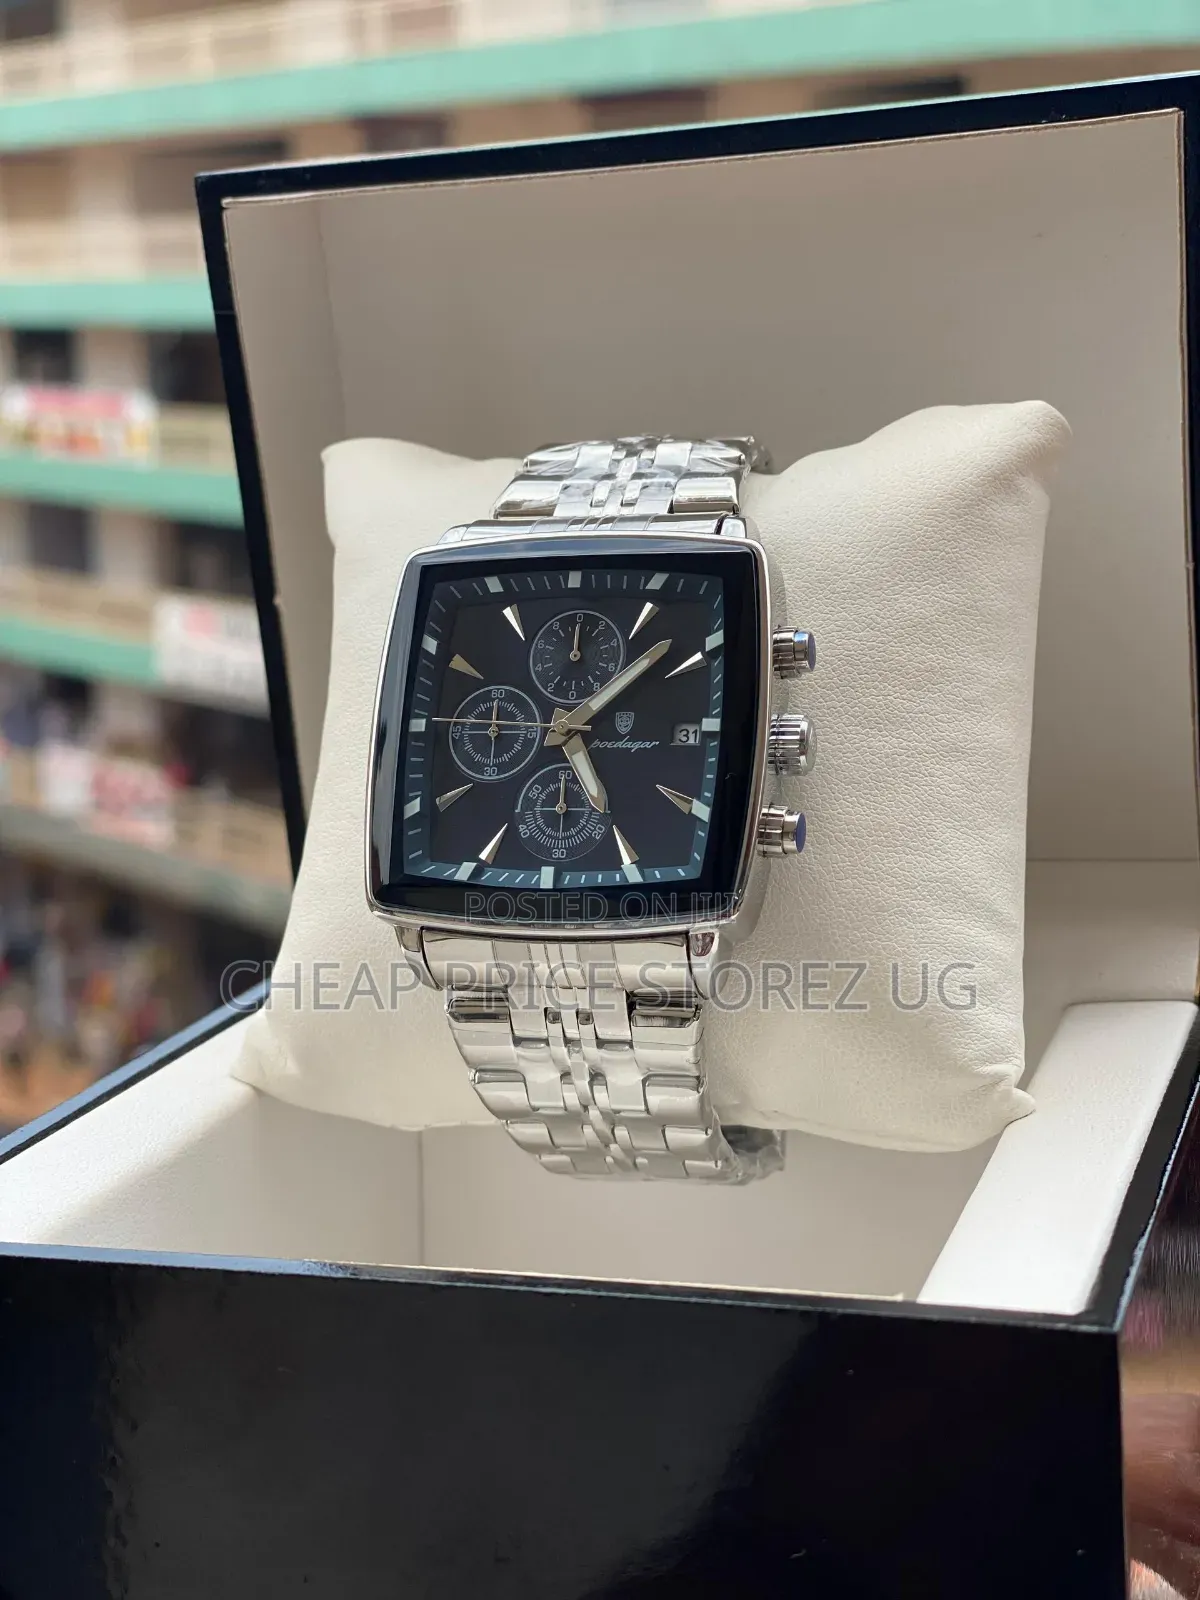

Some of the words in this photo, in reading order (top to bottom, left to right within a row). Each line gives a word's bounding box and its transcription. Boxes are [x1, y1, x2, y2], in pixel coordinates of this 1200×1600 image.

[576, 613, 584, 622] 0
[552, 621, 560, 630] 8
[598, 621, 606, 630] 2
[537, 640, 545, 649] 6
[610, 638, 618, 647] 4
[534, 663, 542, 672] 4
[608, 663, 615, 672] 6
[547, 683, 555, 692] 2
[593, 682, 601, 691] 8
[491, 689, 505, 698] 60
[568, 691, 577, 700] 0
[452, 725, 462, 740] 45
[527, 726, 537, 739] 15
[678, 728, 699, 744] 31
[483, 766, 498, 776] 30
[558, 770, 573, 780] 60
[528, 784, 542, 799] 50
[518, 824, 530, 839] 40
[591, 824, 605, 840] 20
[552, 848, 567, 859] 30
